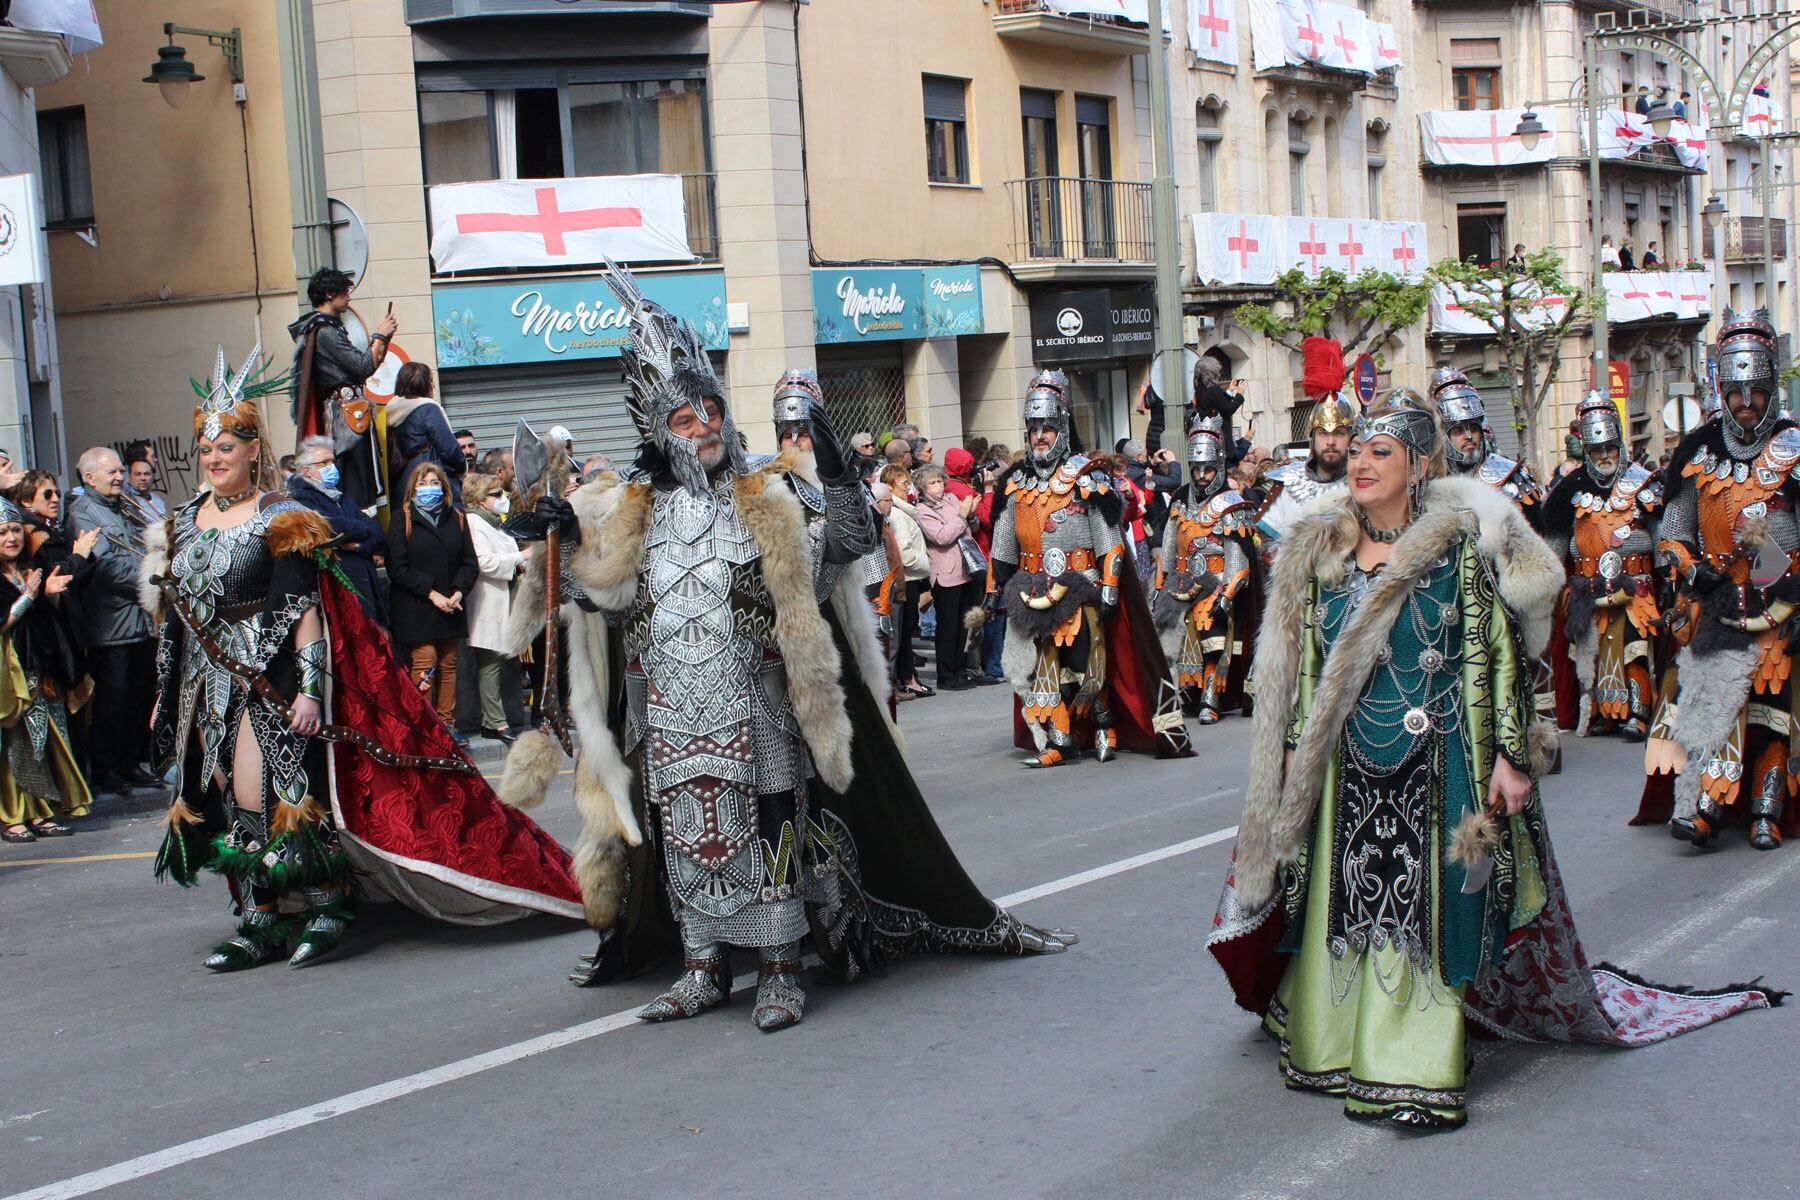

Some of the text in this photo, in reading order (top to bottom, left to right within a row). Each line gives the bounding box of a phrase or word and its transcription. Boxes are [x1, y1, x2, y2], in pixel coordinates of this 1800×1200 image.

[930, 278, 975, 302] Mariola
[837, 276, 905, 335] Mariola
[1121, 306, 1151, 324] IBÉRICO
[1036, 335, 1104, 347] EL SECRETO IBÉRICO
